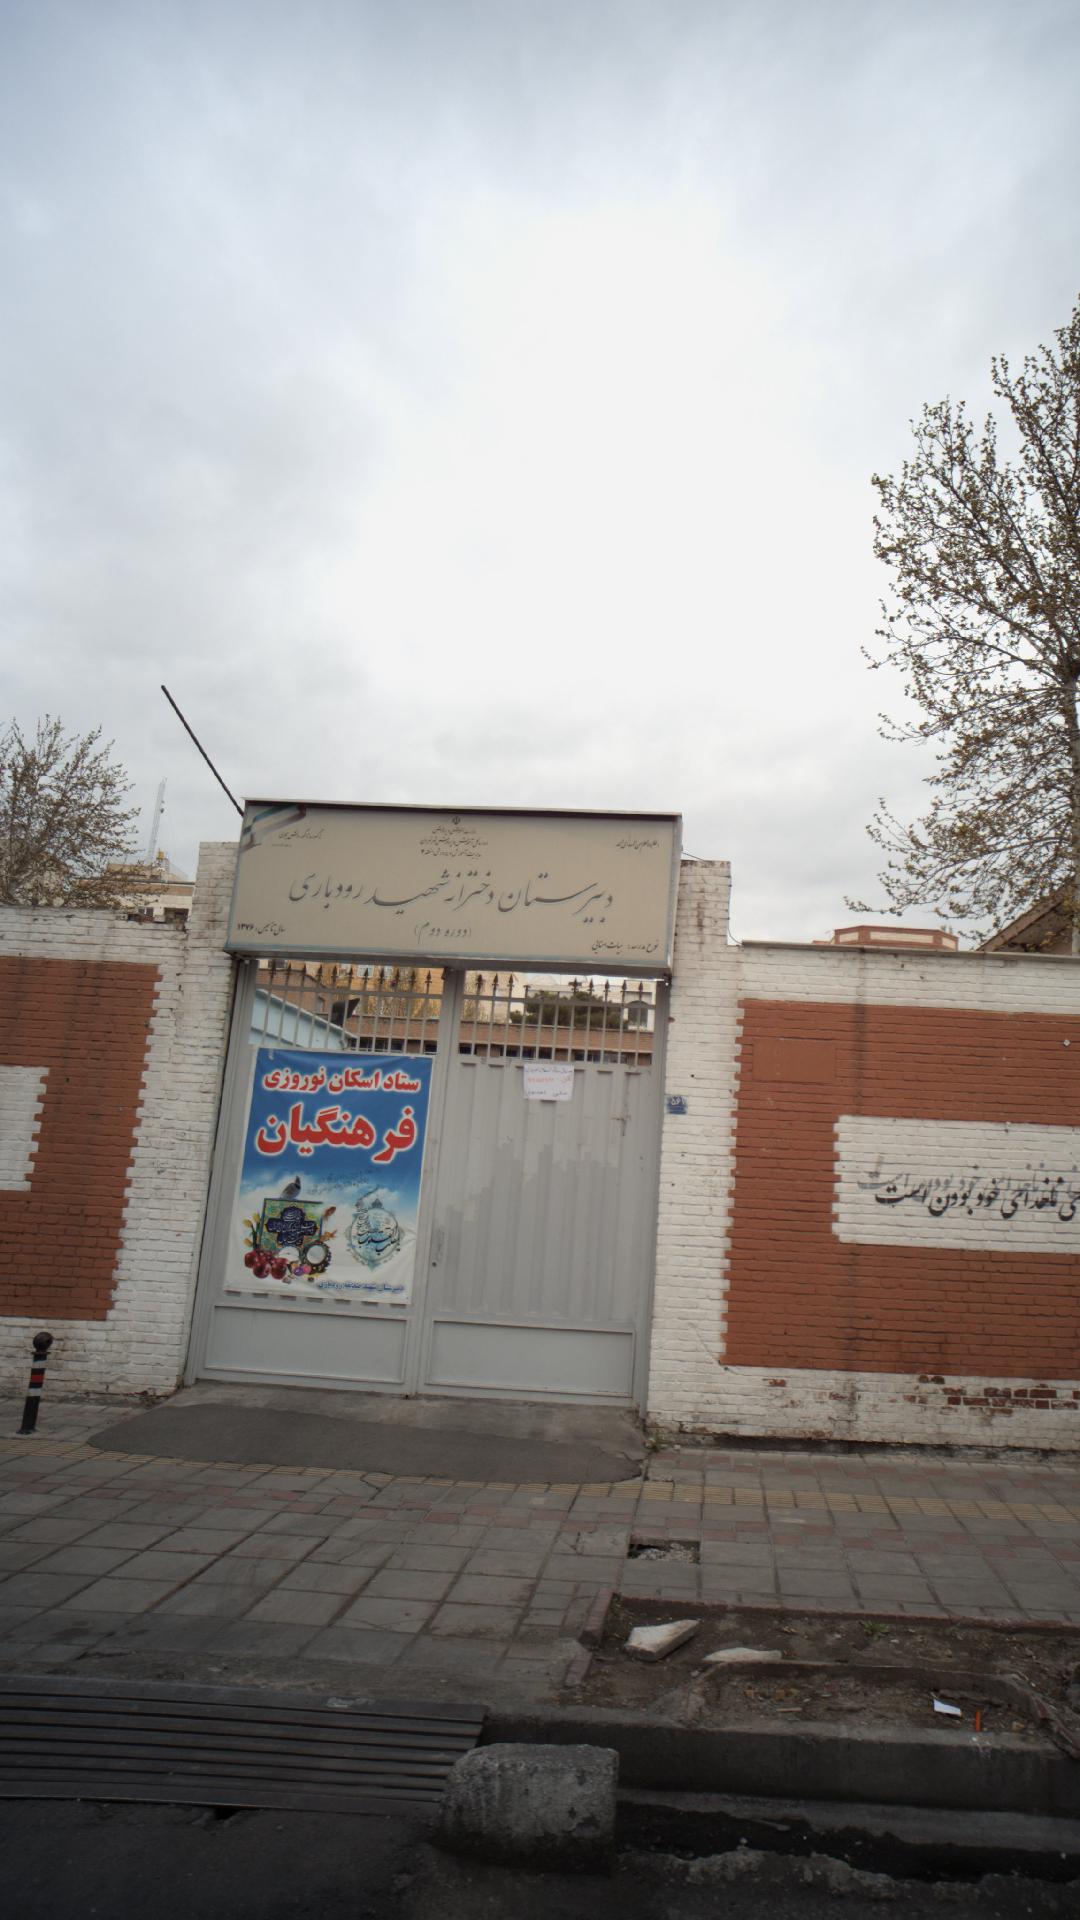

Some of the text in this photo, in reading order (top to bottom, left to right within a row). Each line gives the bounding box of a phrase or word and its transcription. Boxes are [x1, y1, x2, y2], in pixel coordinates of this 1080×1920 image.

[289, 873, 364, 909] رودباری
[363, 869, 450, 915] شهید
[498, 872, 613, 923] دبیرستان
[264, 1066, 420, 1093] ستاد اسکان نوروزی
[256, 1102, 417, 1162] فرهنگیان
[875, 1184, 928, 1205] است
